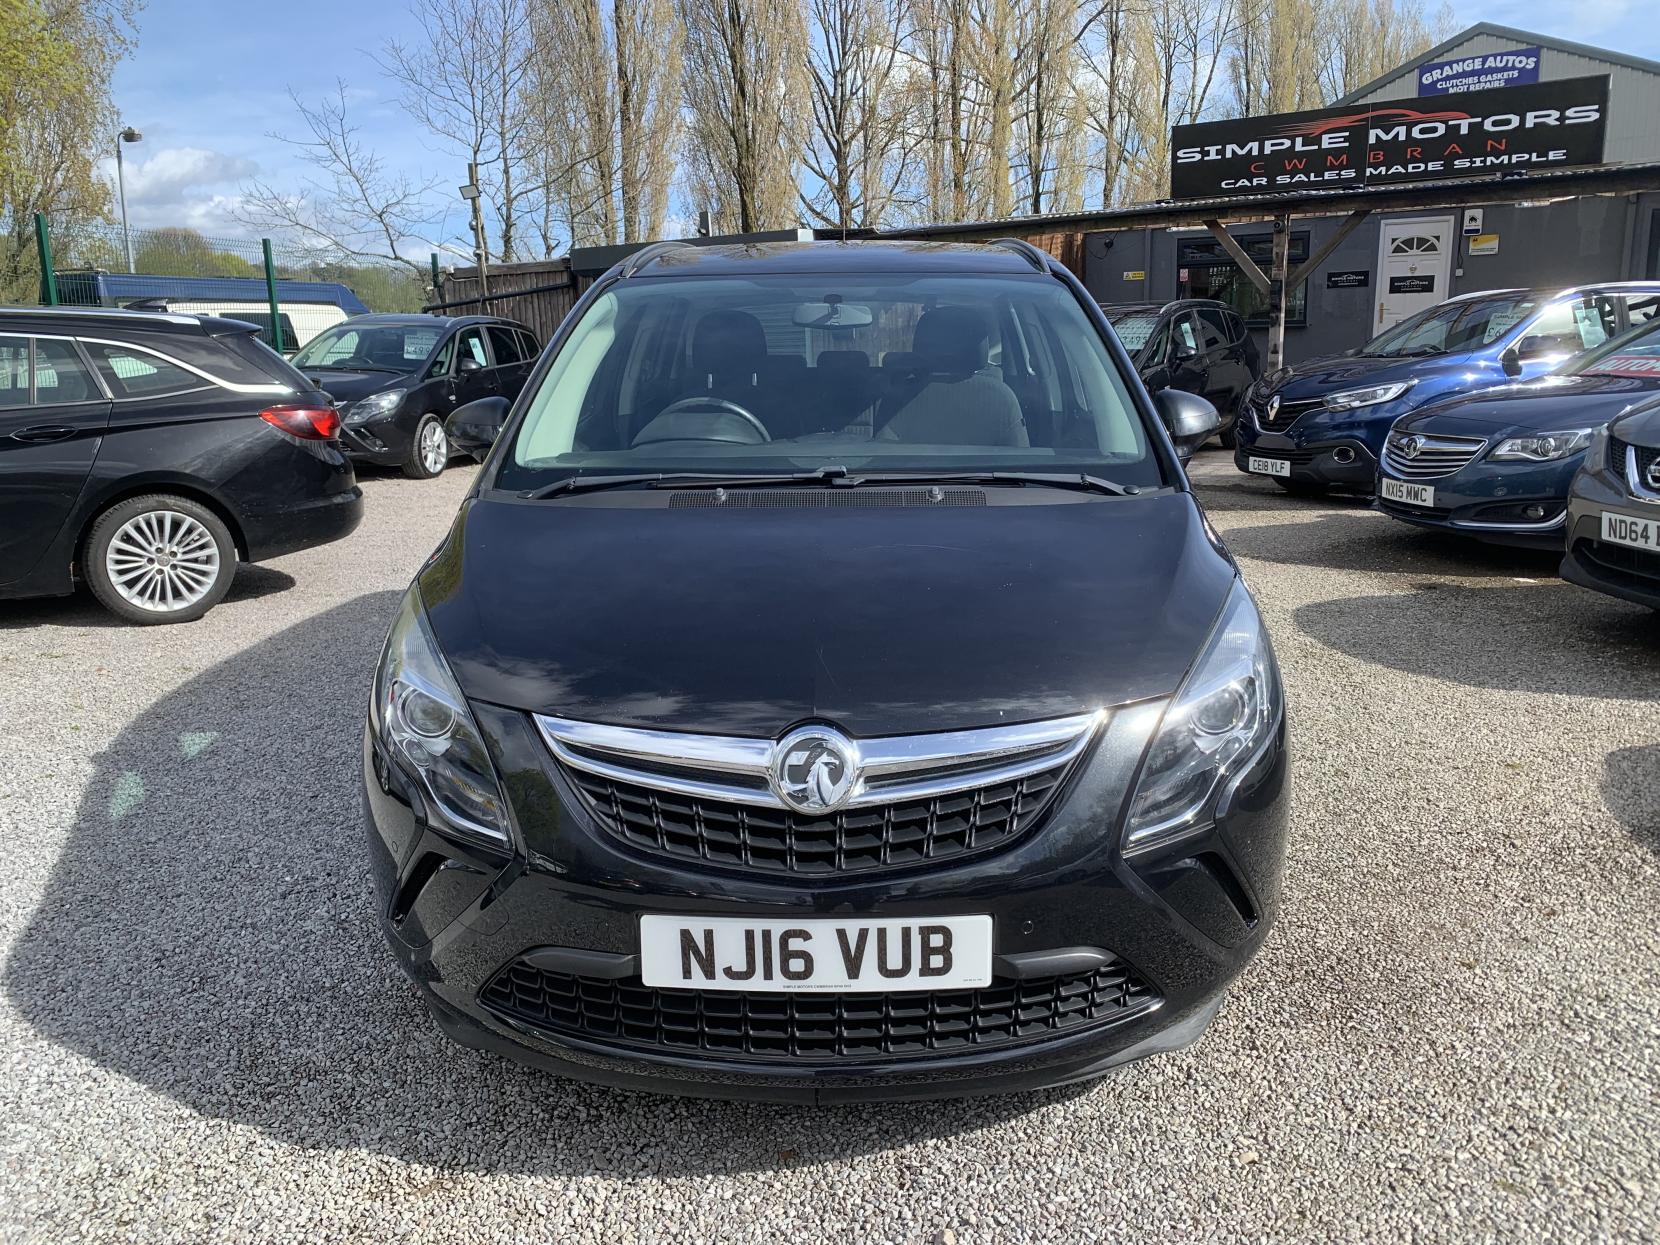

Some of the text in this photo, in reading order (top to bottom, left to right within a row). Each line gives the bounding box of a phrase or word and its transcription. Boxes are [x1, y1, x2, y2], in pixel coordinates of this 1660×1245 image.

[1422, 55, 1537, 84] GRANGE AUTOS
[1437, 70, 1519, 89] CLUTCHES GASKETS
[1449, 80, 1505, 94] MOT REPAIRS
[1176, 104, 1600, 164] SIMPLE MOTORS
[1220, 149, 1567, 189] CAR SALES MADE SIMPLE
[1270, 461, 1285, 474] YLF
[1405, 487, 1428, 503] MWC
[1608, 517, 1651, 545] ND64
[679, 925, 953, 981] NJ16 VUB
